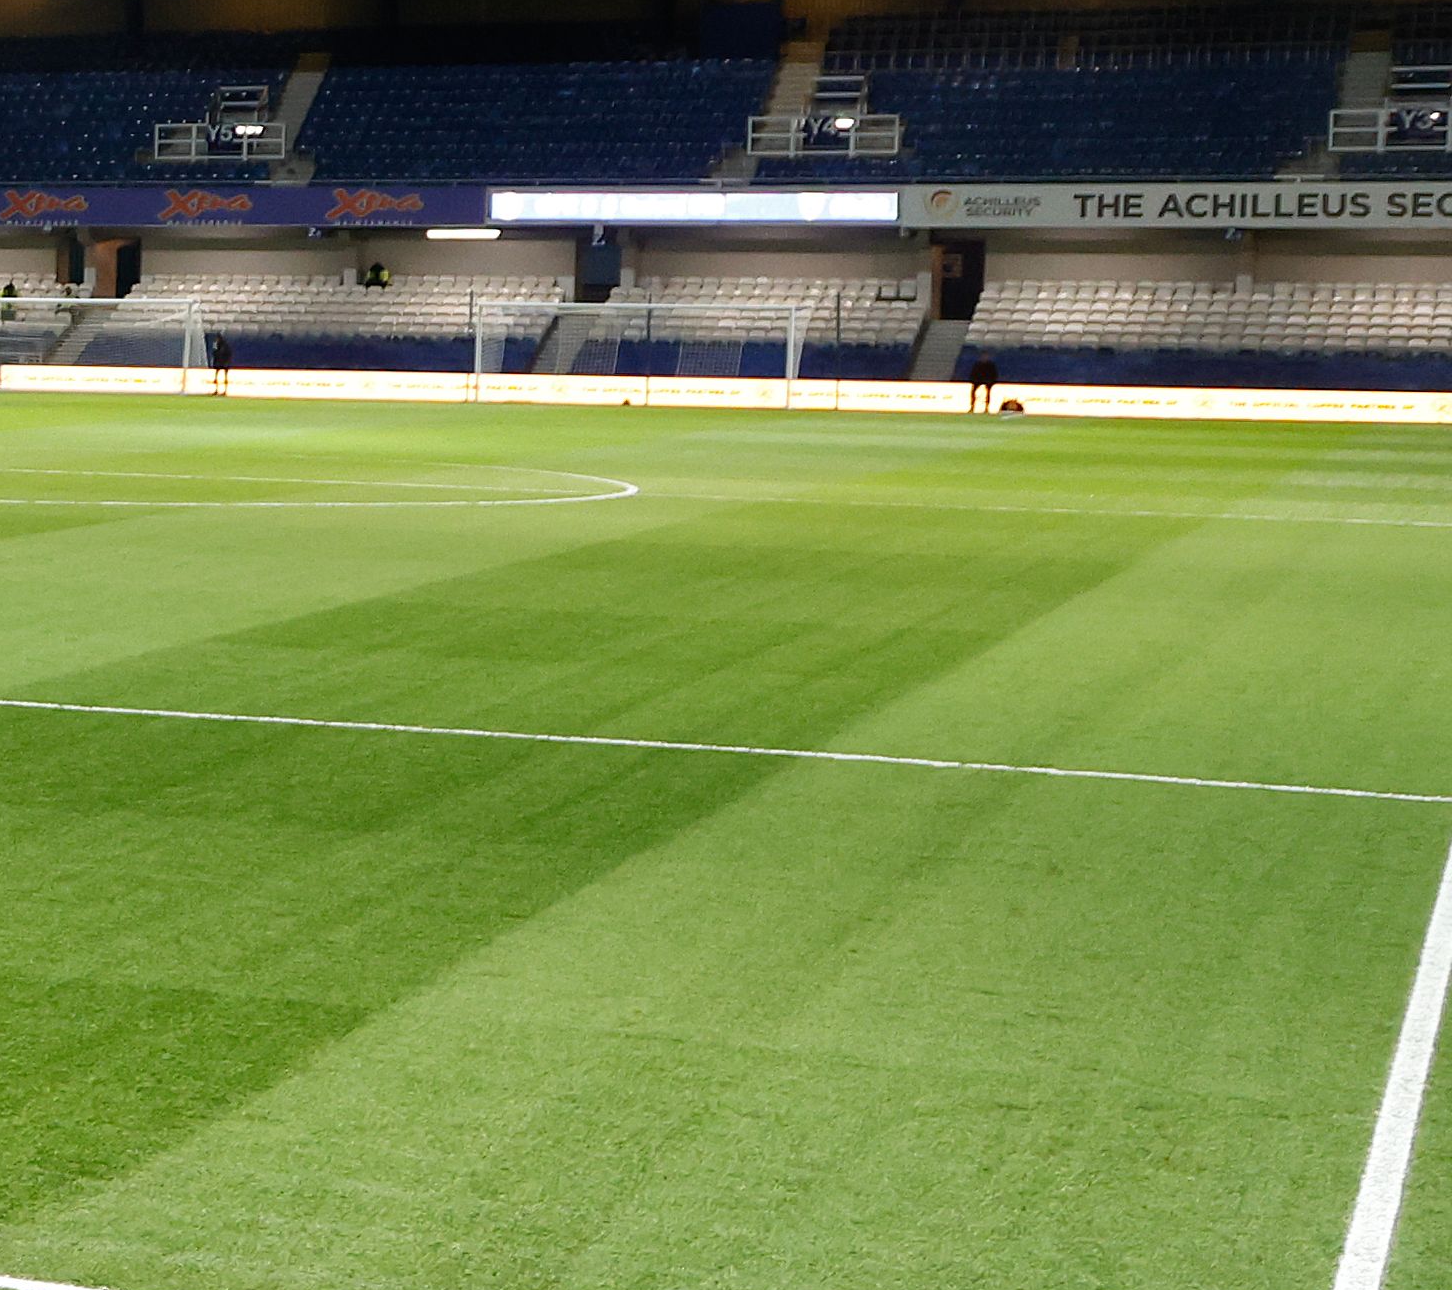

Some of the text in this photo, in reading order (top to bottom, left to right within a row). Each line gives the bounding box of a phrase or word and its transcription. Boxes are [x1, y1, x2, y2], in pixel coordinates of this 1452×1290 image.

[208, 124, 233, 142] Y5
[965, 197, 1040, 207] ACHILLEUS
[1074, 194, 1143, 218] THE
[1158, 193, 1370, 218] ACHILLEUS
[966, 207, 1034, 216] SECURITY
